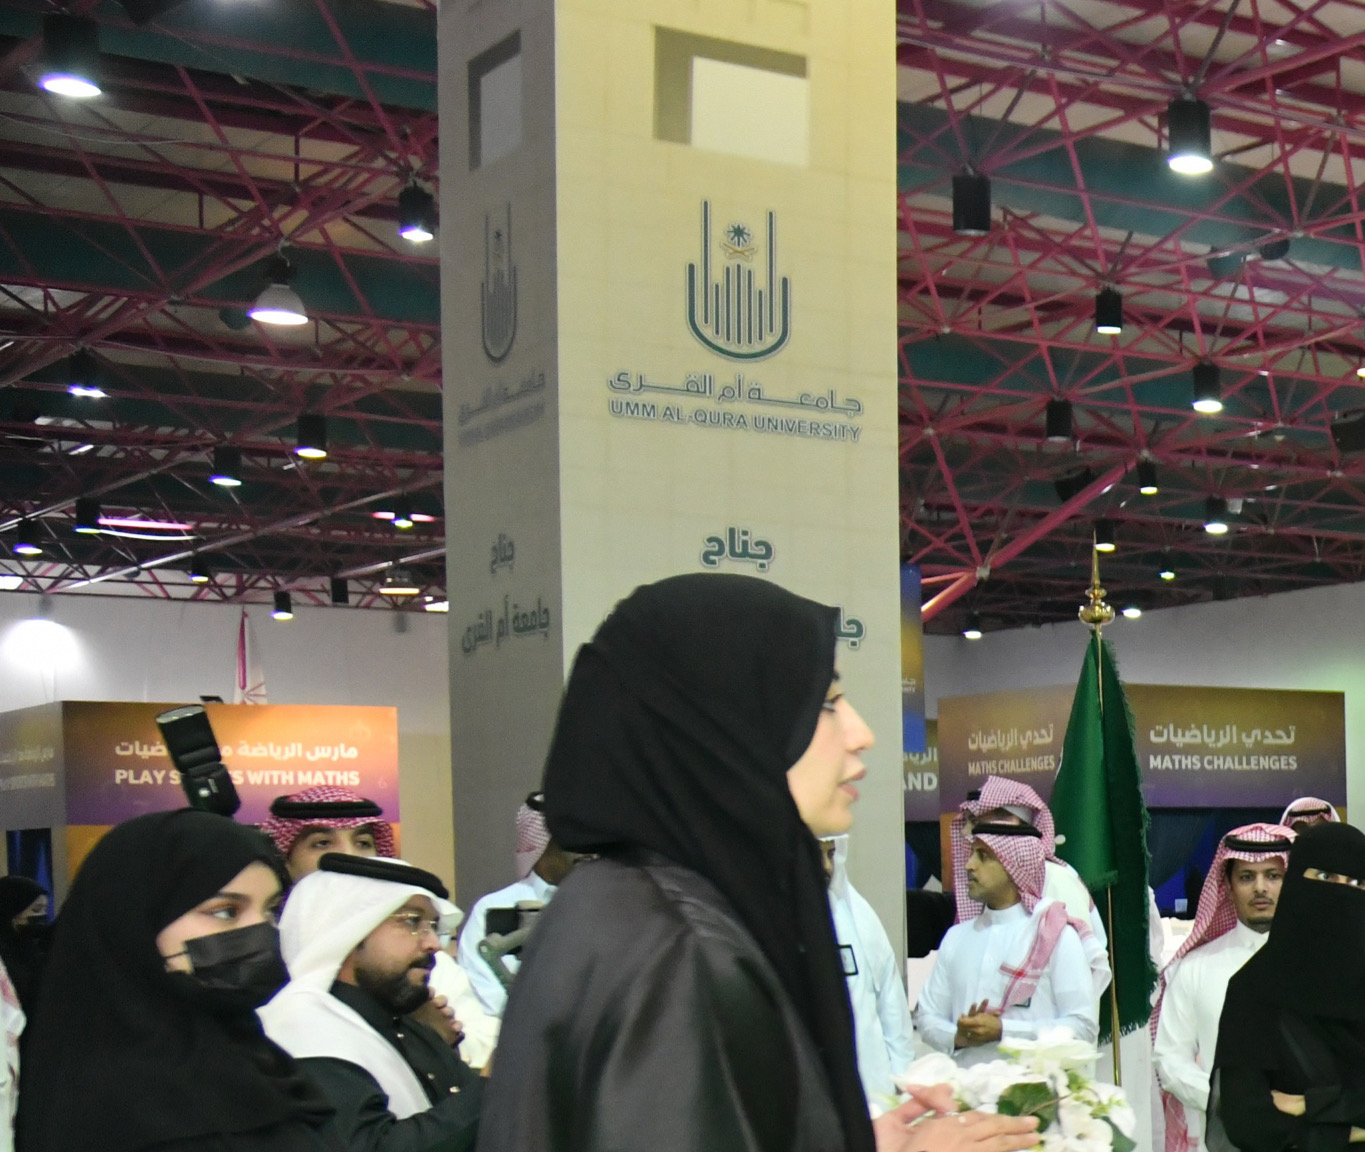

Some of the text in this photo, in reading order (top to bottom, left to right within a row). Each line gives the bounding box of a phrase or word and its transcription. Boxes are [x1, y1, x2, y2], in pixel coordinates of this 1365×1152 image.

[609, 372, 863, 416] جامعة أم القرى
[609, 400, 862, 441] UMM AL-QURA UNIVERSITY
[702, 527, 774, 569] جناح
[968, 723, 1054, 753] تحدي الرياضيات
[1149, 723, 1296, 748] تحدي الرياضيات
[237, 740, 301, 762] الرياضة
[305, 743, 359, 762] مارس
[968, 755, 1055, 776] MATHS CHALLENGES
[1149, 754, 1298, 771] MATHS CHALLENGES
[114, 769, 168, 786] PLAY
[247, 770, 295, 786] WITH
[297, 770, 361, 786] MATHS
[902, 771, 938, 791] ND
